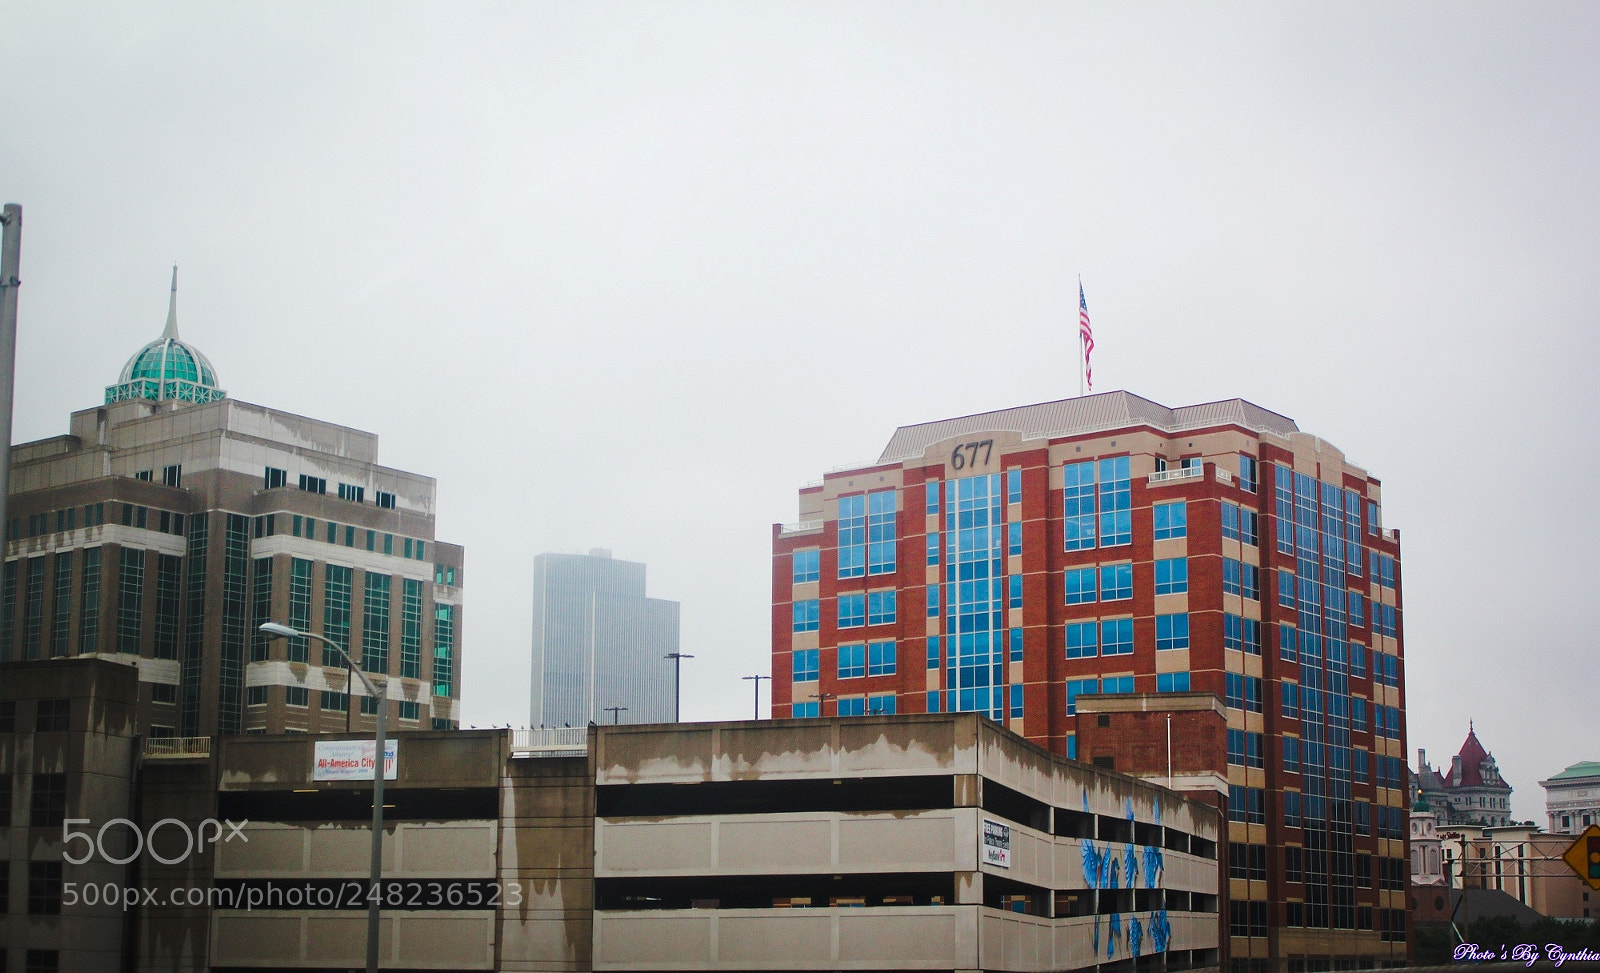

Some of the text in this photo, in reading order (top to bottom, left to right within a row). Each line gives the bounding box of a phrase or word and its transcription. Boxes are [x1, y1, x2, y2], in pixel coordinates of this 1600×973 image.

[951, 439, 993, 470] 677
[318, 758, 376, 770] All-America City
